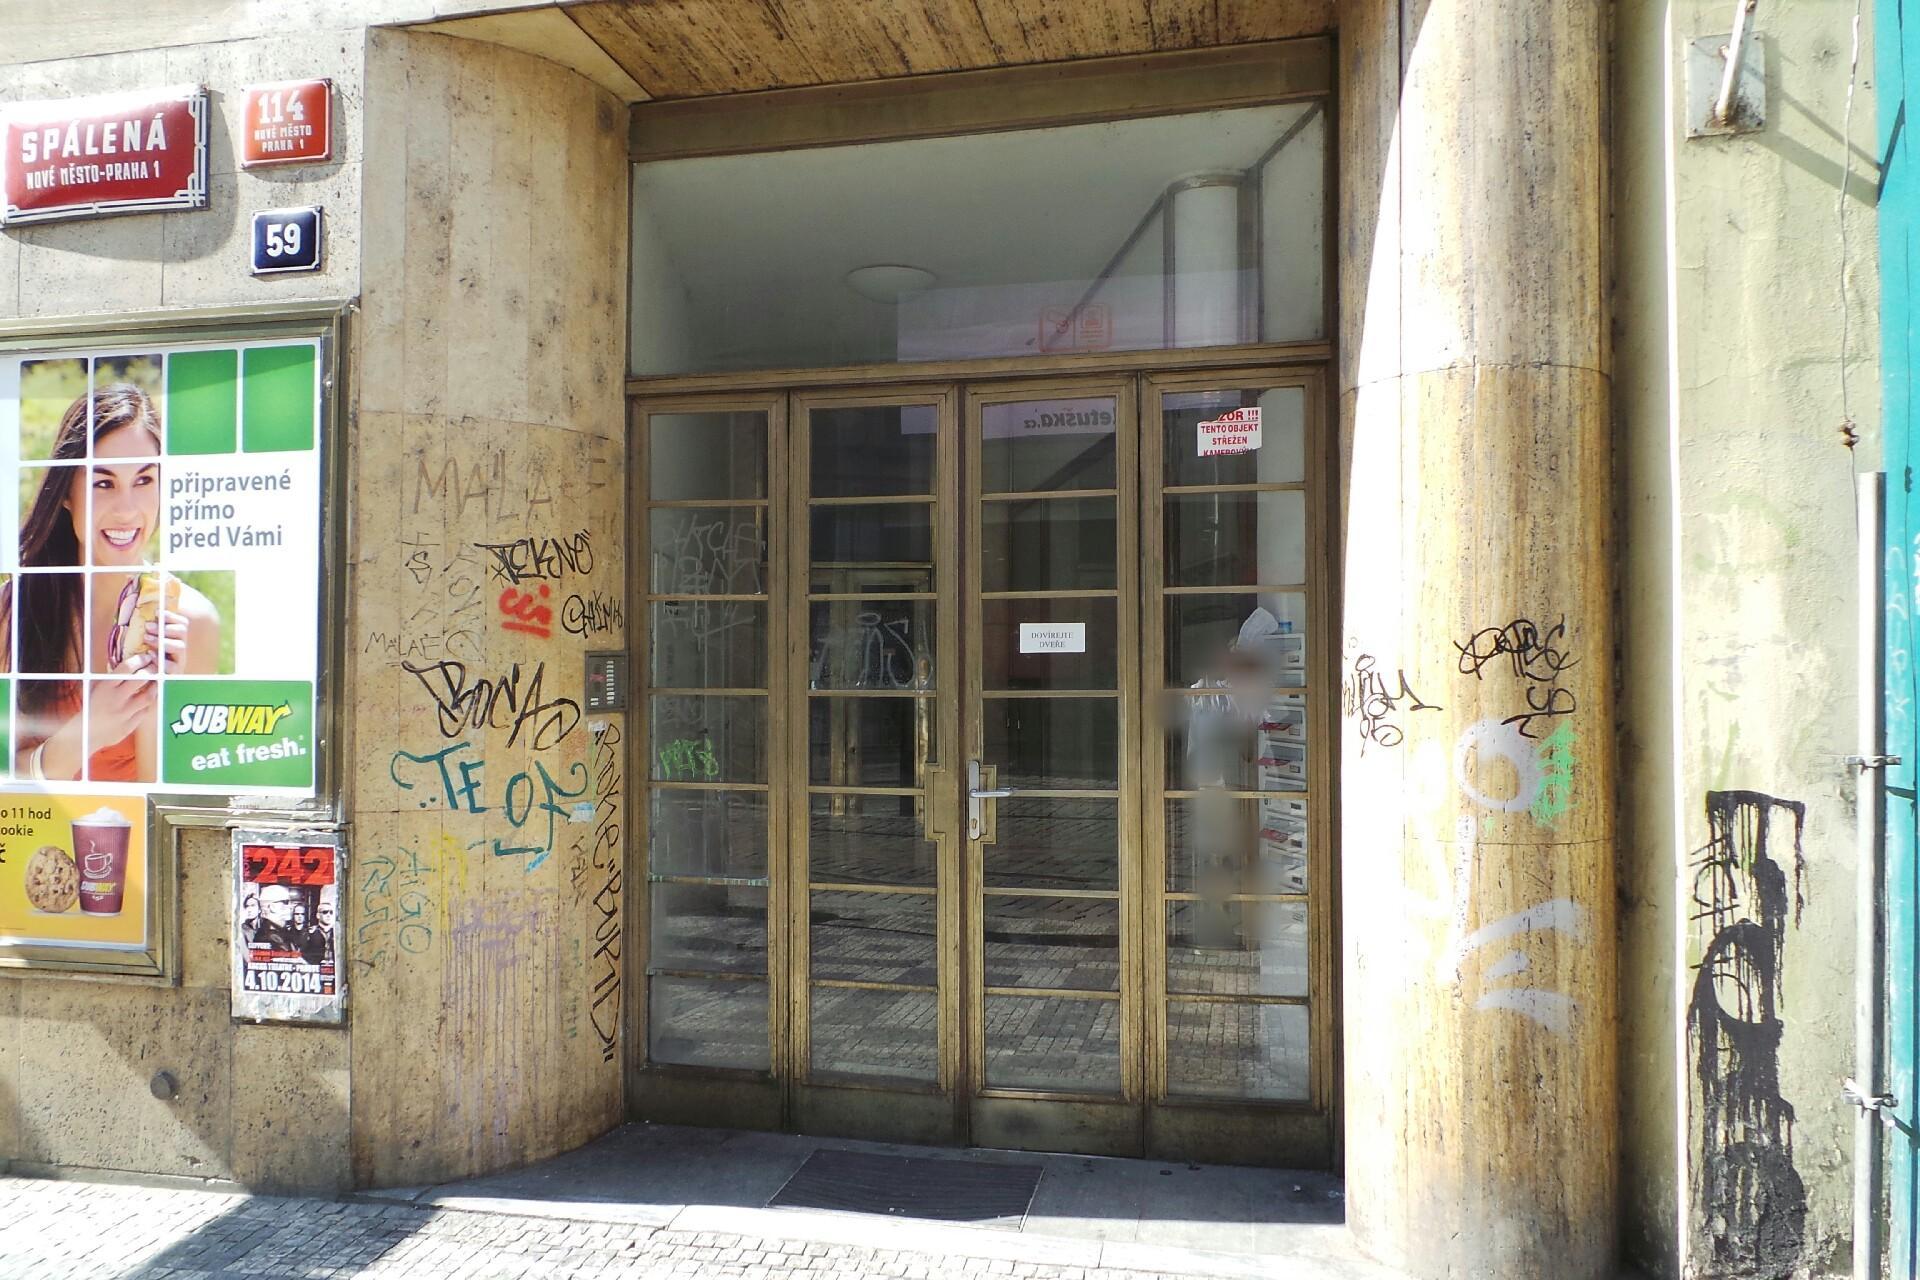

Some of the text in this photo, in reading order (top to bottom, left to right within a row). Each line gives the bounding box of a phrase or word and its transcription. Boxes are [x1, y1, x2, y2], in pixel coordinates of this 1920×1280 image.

[257, 90, 304, 124] 114
[22, 112, 167, 163] SPÁLENÁ
[254, 123, 312, 140] NOVÉ MĚSTO
[262, 138, 304, 152] PRAHA 1
[26, 160, 160, 190] NOVÉ MĚSTO-PRAHA 1
[266, 222, 301, 257] 59
[1200, 423, 1259, 434] TENTO OBJEKT
[1212, 434, 1248, 446] STŘEŽEN
[170, 468, 292, 499] připravené
[170, 499, 235, 526] přímo
[169, 524, 283, 554] před Vámi
[170, 700, 293, 738] SUBWAY
[191, 747, 231, 771] eat
[12, 807, 24, 819] 11
[28, 807, 52, 820] hod
[251, 847, 330, 884] 242
[244, 970, 321, 993] 4.10.2014
